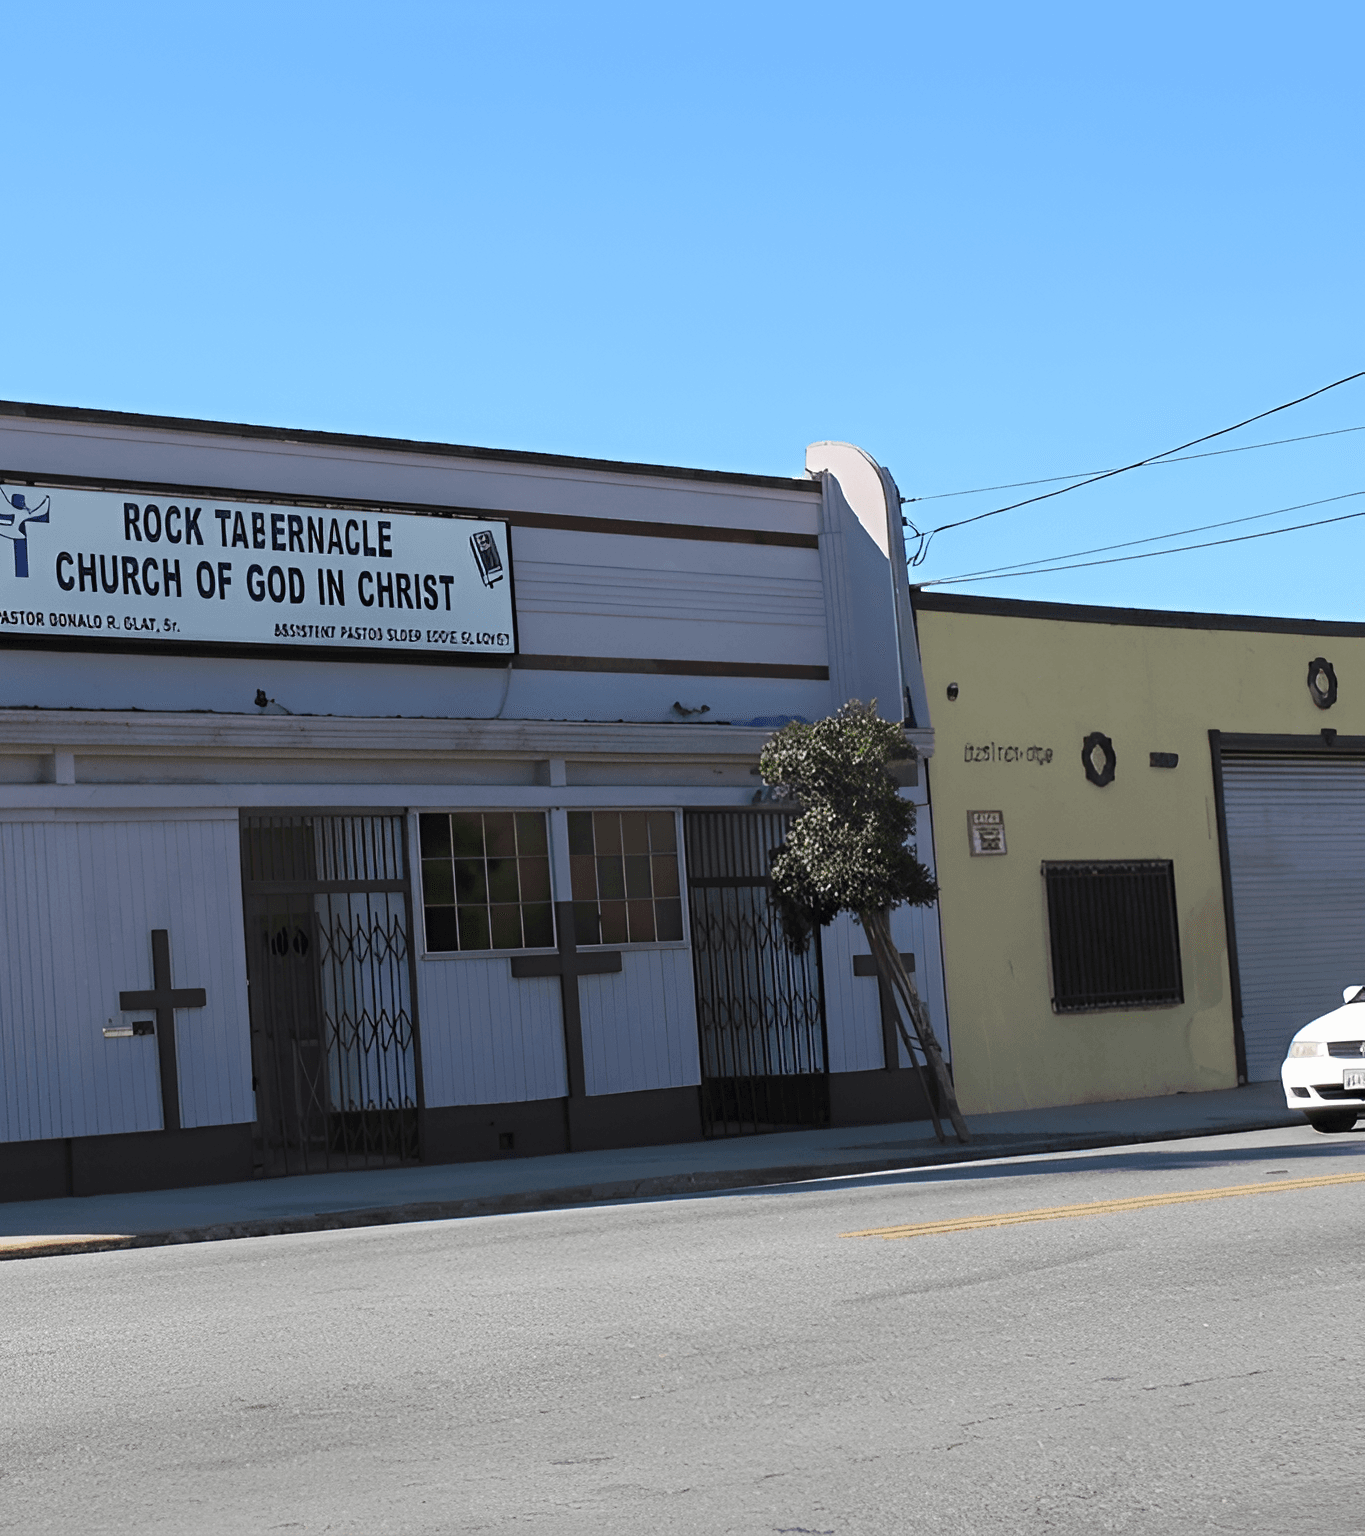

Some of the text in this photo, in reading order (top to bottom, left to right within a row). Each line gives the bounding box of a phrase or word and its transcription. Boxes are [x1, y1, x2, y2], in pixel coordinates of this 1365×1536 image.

[123, 502, 393, 558] ROCK TABERNACLE
[55, 551, 455, 611] CHURCH OF GOD IN CHRIST
